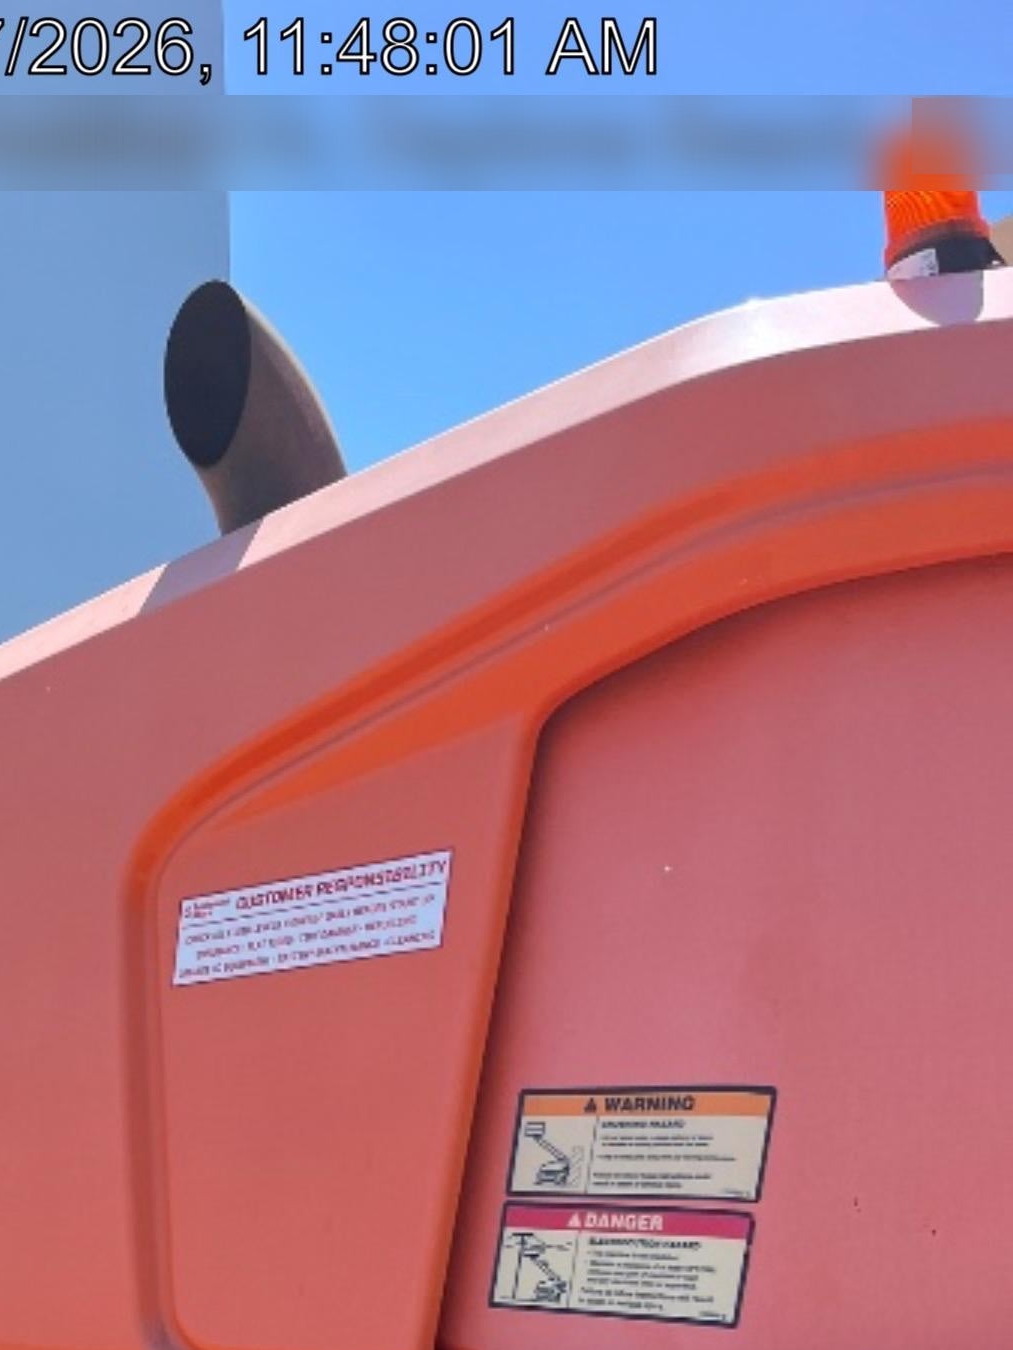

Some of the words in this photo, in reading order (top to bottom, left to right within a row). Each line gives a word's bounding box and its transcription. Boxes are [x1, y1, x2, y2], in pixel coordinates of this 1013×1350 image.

[235, 882, 312, 911] CUSTOMER
[316, 859, 448, 897] RESPONSIBILITY
[605, 1095, 696, 1112] WARNING
[583, 1212, 664, 1231] DANGER
